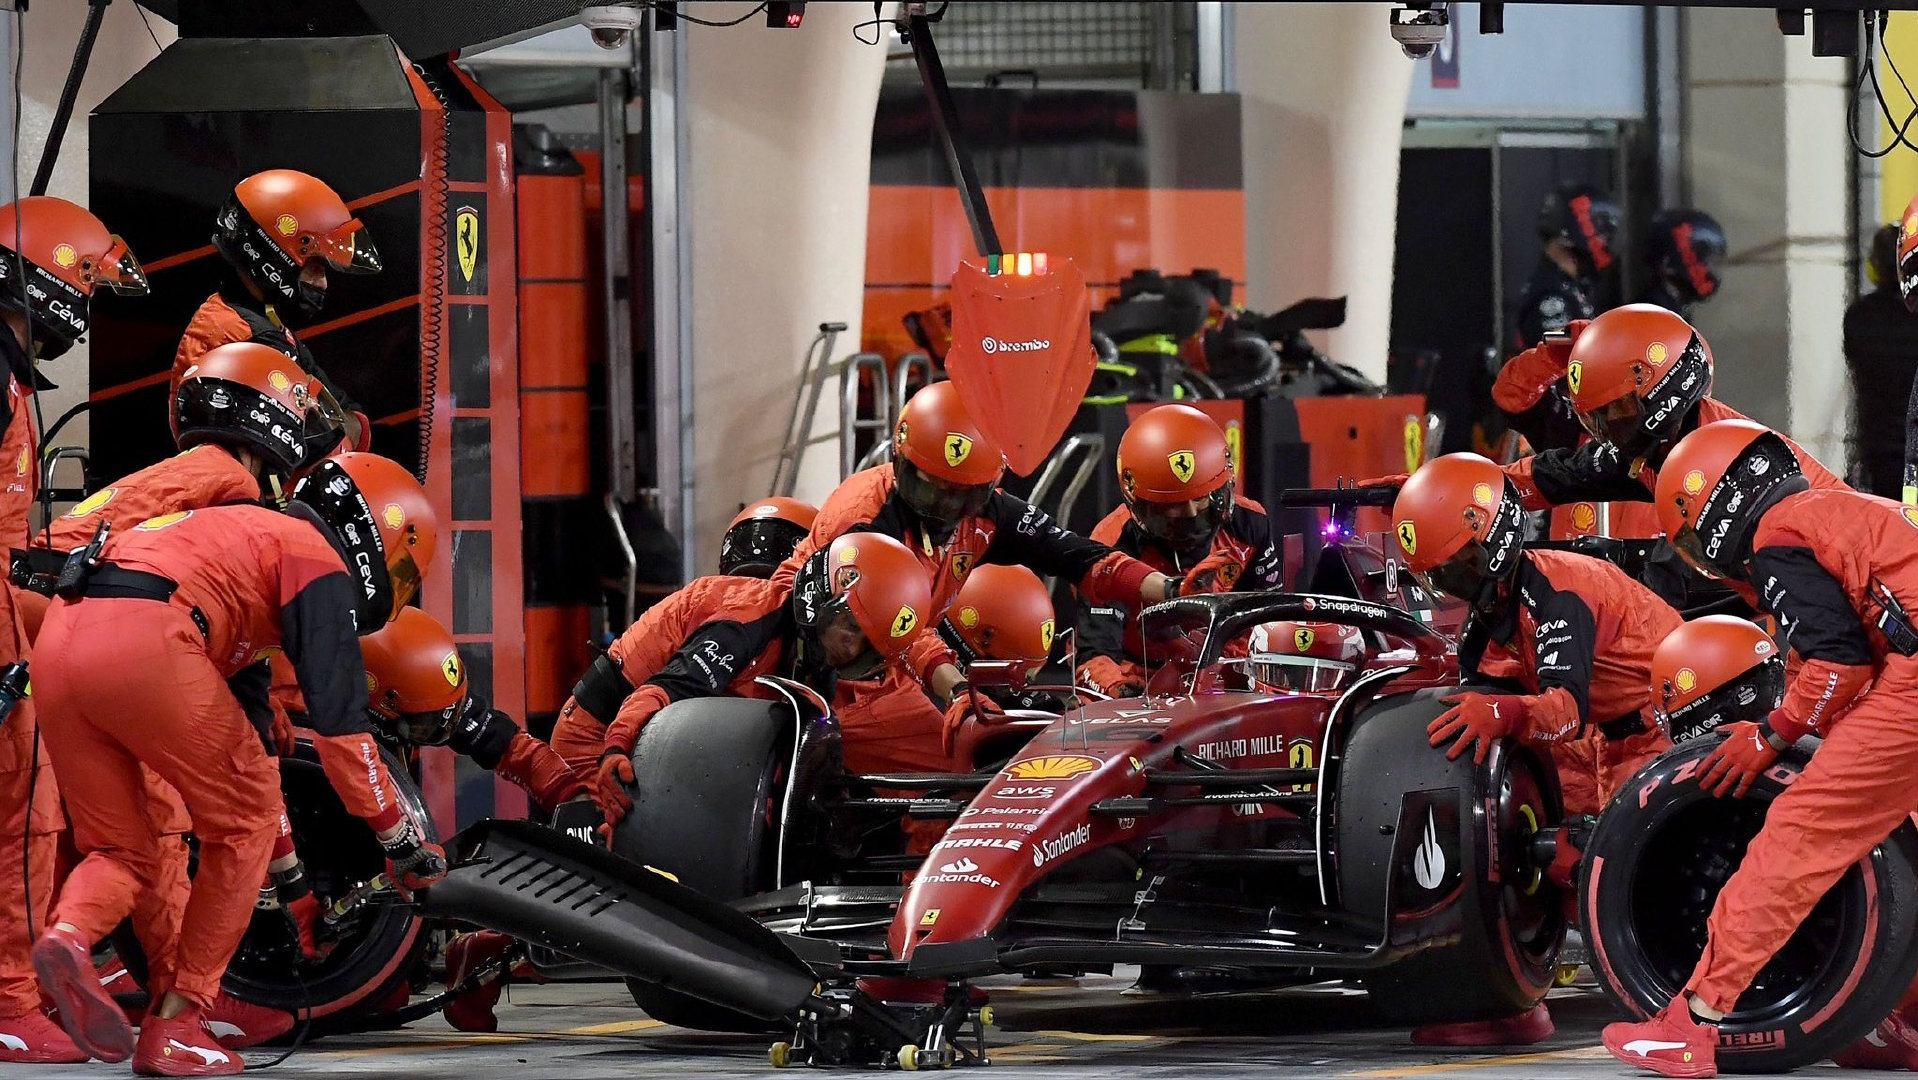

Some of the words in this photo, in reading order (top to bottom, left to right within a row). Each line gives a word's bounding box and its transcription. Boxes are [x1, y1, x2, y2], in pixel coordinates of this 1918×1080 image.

[36, 267, 65, 288] RICHARD
[65, 284, 83, 298] MILLE
[999, 339, 1050, 352] brembo
[1711, 482, 1726, 504] MILLE
[1706, 518, 1733, 559] CEVA
[1489, 531, 1515, 572] CEVA
[356, 551, 377, 600] CEVA
[1320, 599, 1387, 618] Snapdragon
[1536, 619, 1568, 638] CEVA
[704, 640, 734, 673] Ray-Ban
[1671, 705, 1692, 719] RICHARD
[1693, 695, 1711, 708] MILLE
[1070, 717, 1173, 725] VELAS
[1199, 739, 1247, 761] RICHARD
[1251, 734, 1284, 756] MILLE
[997, 787, 1057, 795] aws
[1638, 776, 1661, 809] P
[981, 807, 1051, 816] Palantir
[930, 839, 1023, 853] MAHLE
[1043, 823, 1091, 863] Santander
